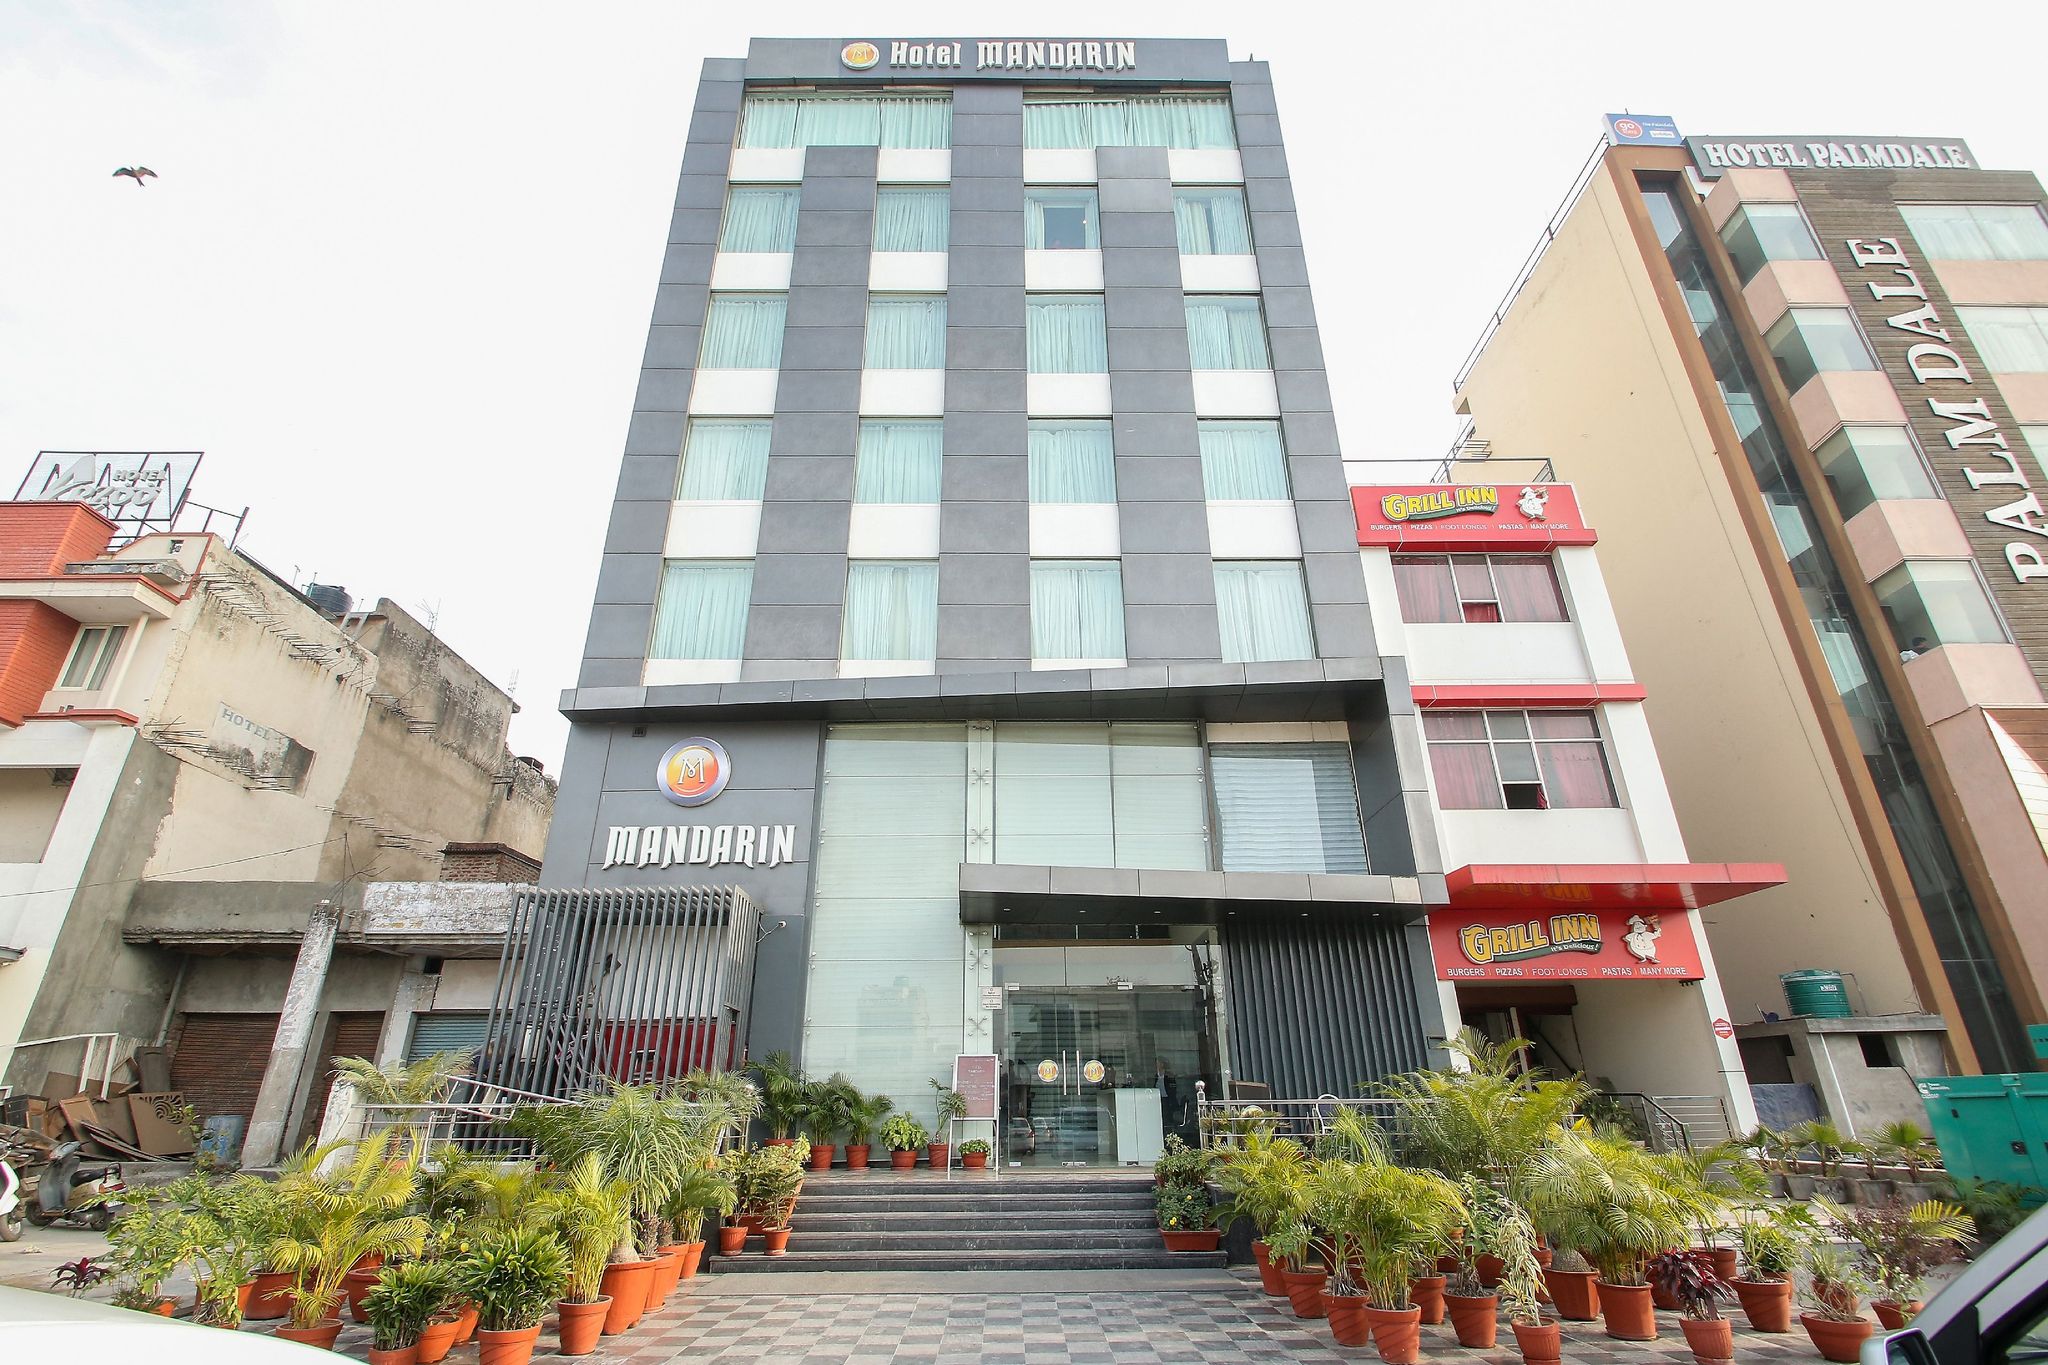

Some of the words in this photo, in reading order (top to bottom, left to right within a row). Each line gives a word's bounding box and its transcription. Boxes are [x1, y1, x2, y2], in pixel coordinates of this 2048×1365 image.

[889, 41, 961, 68] Hotel
[976, 41, 1136, 71] MANDARIN
[1702, 143, 1808, 168] HOTEL
[1806, 143, 1971, 169] PALMDALE
[1846, 237, 2048, 584] PALMDALE
[112, 470, 168, 481] HOTEL
[1382, 491, 1455, 521] GRILL
[1454, 486, 1497, 507] INN
[221, 707, 272, 741] HOTEL
[601, 824, 797, 870] MANDARIN
[1461, 920, 1549, 964] GRILL
[1550, 913, 1600, 944] INN
[1447, 968, 1486, 976] BURGERS
[1495, 968, 1523, 976] PIZZAS
[1532, 968, 1556, 976] FOOT
[1558, 968, 1588, 976] LONGS
[1601, 967, 1632, 976] PASTAS
[1639, 967, 1662, 975] MANY
